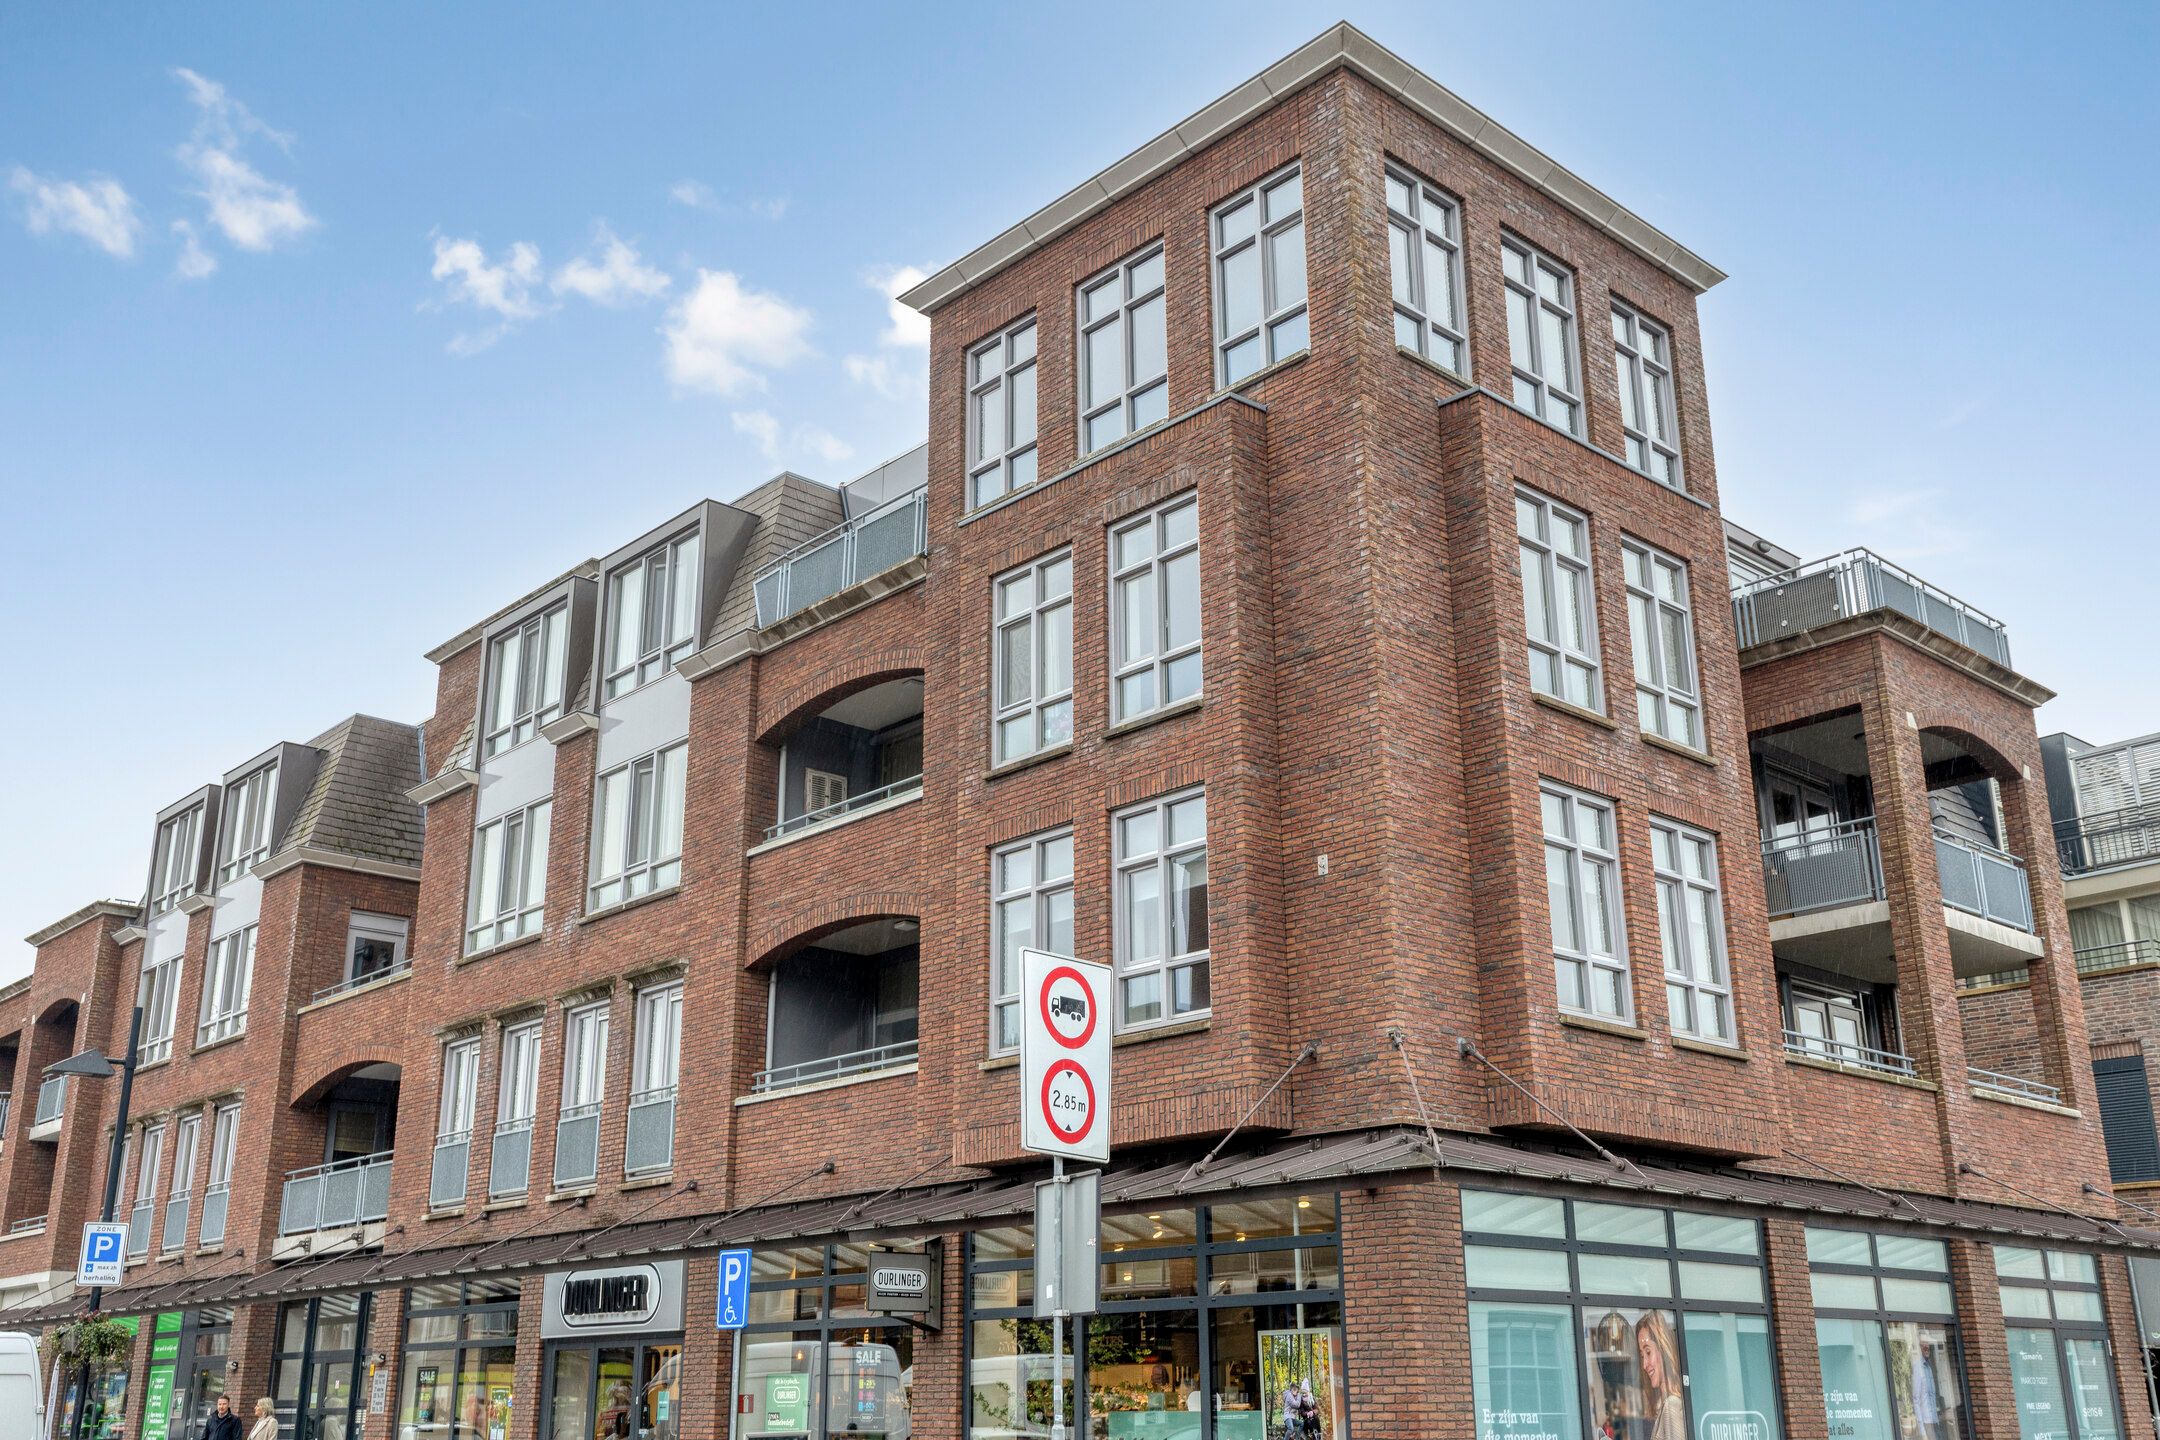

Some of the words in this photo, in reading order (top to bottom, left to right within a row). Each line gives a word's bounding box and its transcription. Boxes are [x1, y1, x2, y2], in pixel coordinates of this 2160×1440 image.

[1053, 1090, 1076, 1110] 2.85
[1078, 1102, 1086, 1112] m
[94, 1236, 114, 1259] P
[724, 1258, 742, 1296] P
[878, 1272, 922, 1287] DURLINGER
[564, 1275, 648, 1315] DURLINGER
[855, 1350, 882, 1364] SALE
[420, 1371, 436, 1382] SALE
[1830, 1389, 1844, 1405] zijn
[1844, 1392, 1858, 1402] van
[1482, 1408, 1496, 1424] Er
[1499, 1409, 1518, 1428] zijn
[1519, 1412, 1540, 1424] van
[1835, 1408, 1873, 1419] momenten
[2082, 1407, 2103, 1417] sense
[1504, 1431, 1558, 1440] momenten
[1710, 1423, 1760, 1440] DURLINGER
[1837, 1423, 1855, 1436] alles
